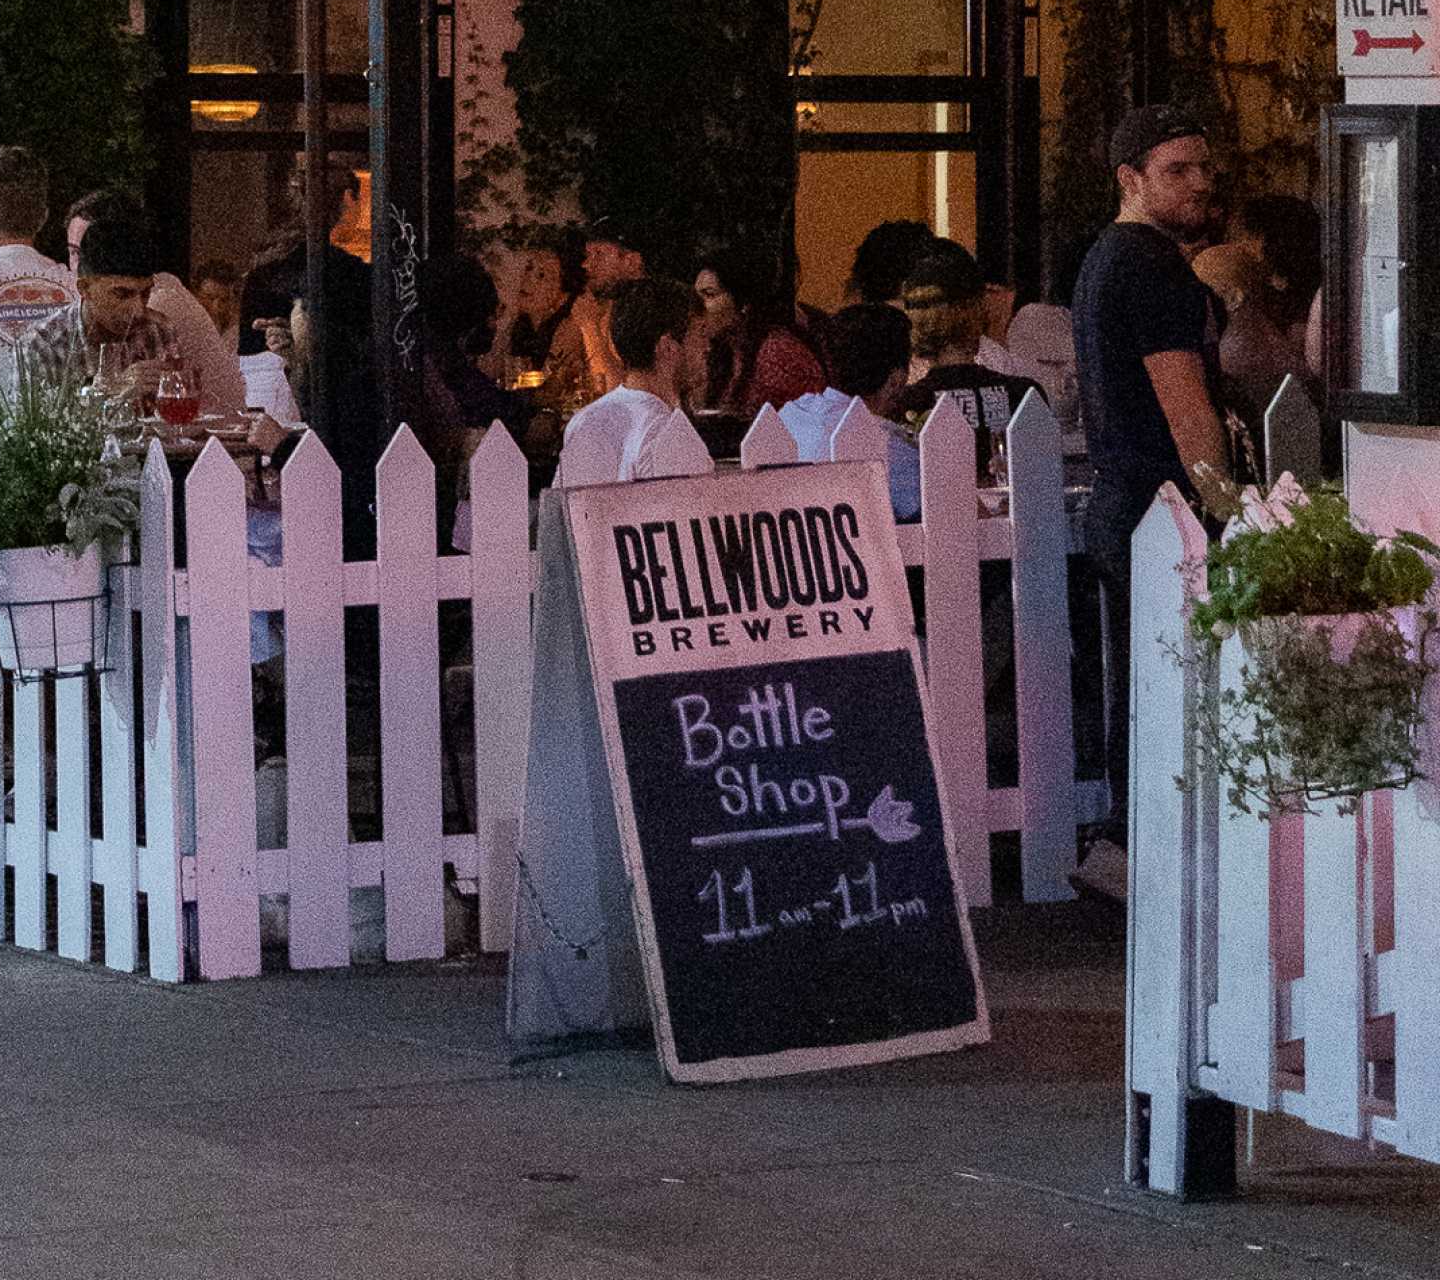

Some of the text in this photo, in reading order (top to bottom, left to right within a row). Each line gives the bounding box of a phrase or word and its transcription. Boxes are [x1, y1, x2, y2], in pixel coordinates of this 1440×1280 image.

[613, 503, 869, 626] BELLWOODS
[632, 606, 874, 656] BREWERY
[674, 682, 835, 767] Bottle
[715, 763, 850, 840] Shop
